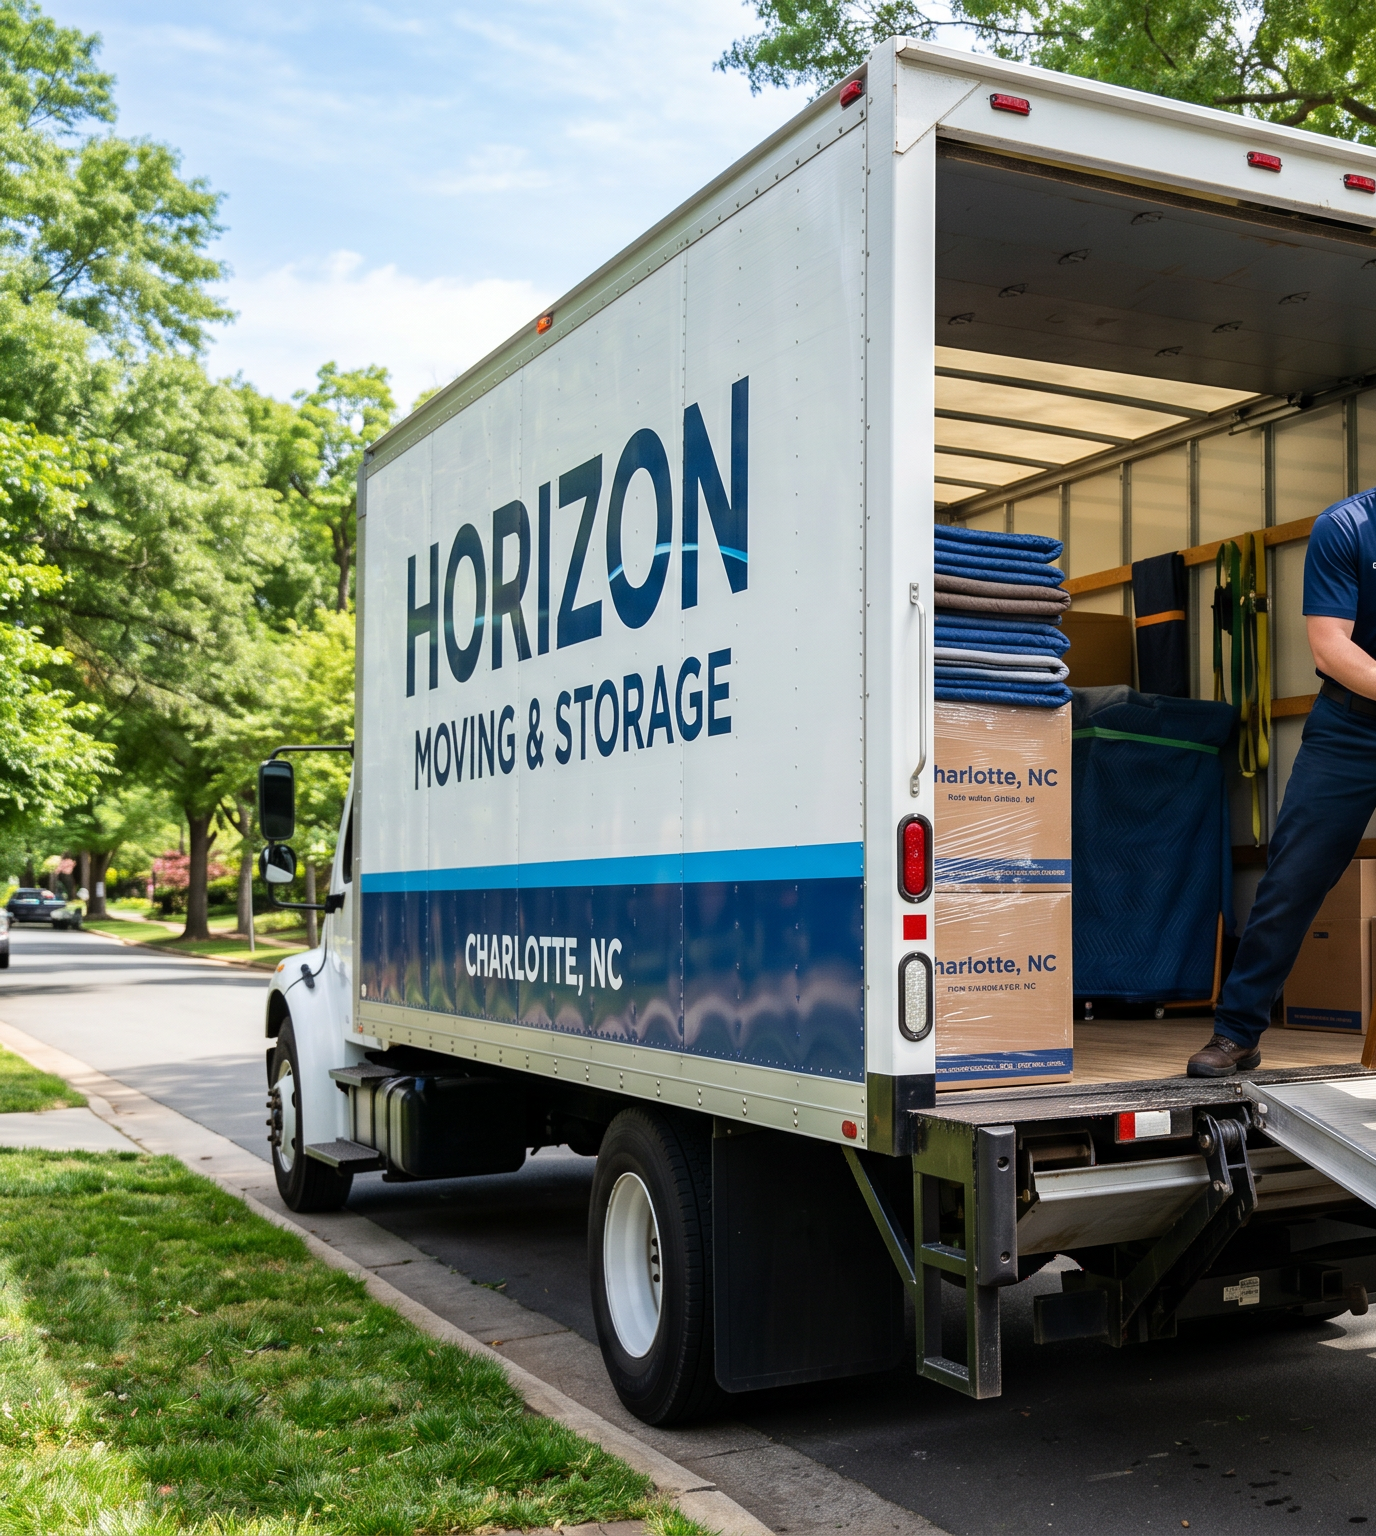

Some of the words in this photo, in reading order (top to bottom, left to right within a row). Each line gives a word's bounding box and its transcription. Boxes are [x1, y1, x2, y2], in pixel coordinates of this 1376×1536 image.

[406, 375, 749, 698] HORIZON
[414, 704, 516, 791] MOVING
[526, 697, 544, 771] &
[554, 647, 732, 766] STORAGE
[934, 765, 1022, 789] harlotte,
[1028, 768, 1058, 787] NC
[465, 933, 584, 996] CHARLOTTE,
[590, 937, 623, 991] NC
[935, 956, 1021, 976] harlotte,
[1028, 954, 1057, 972] NC
[1023, 982, 1036, 990] NC
